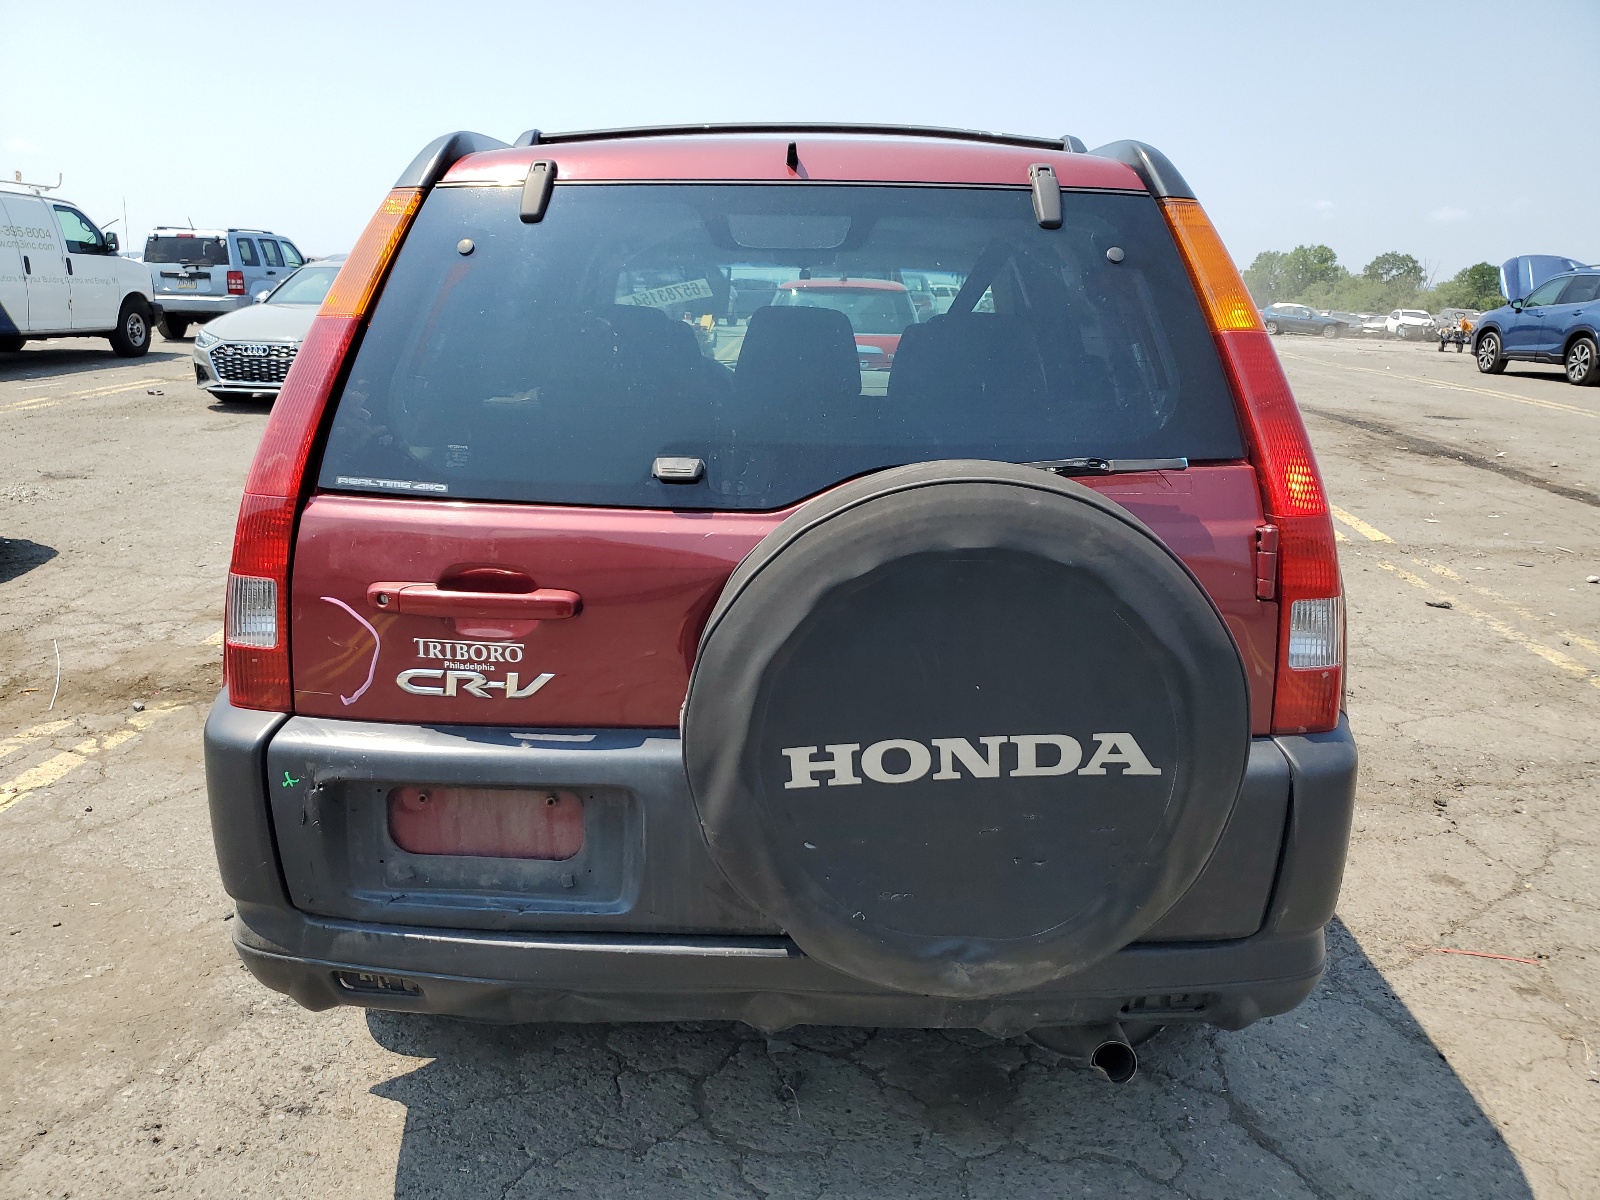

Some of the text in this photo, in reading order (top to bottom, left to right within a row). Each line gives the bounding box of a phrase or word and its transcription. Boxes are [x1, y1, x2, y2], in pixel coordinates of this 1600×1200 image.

[413, 637, 525, 663] TRIBORO
[444, 661, 496, 672] Philadelphia
[396, 668, 556, 699] CR-V
[781, 731, 1162, 790] HONDA
